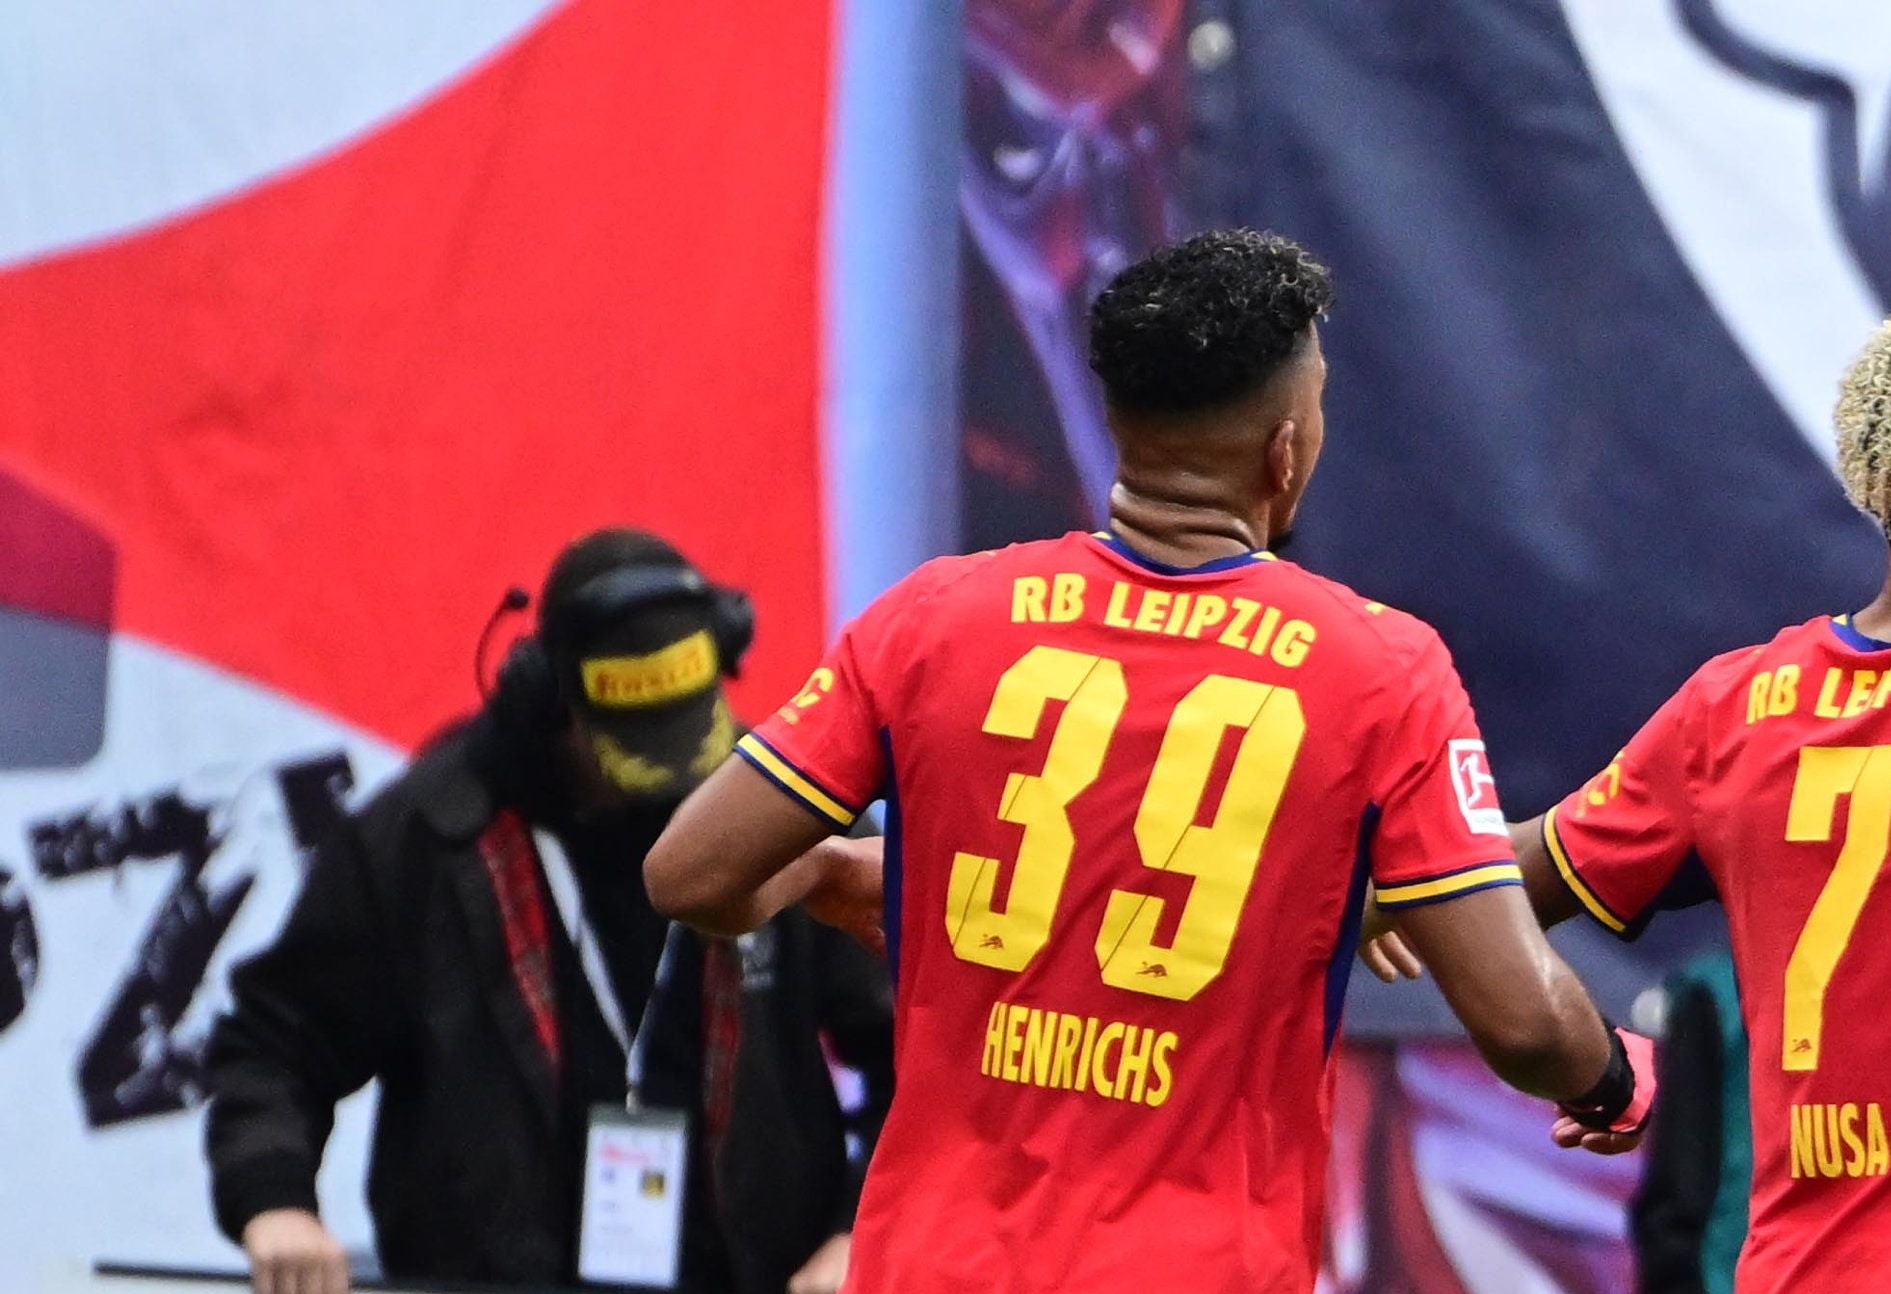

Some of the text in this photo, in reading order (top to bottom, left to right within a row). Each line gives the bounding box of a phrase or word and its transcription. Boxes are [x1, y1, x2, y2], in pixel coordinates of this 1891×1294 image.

[1010, 573, 1317, 669] RB LEIPZIG
[1746, 663, 1802, 725] RB
[944, 644, 1307, 1002] 39
[981, 1001, 1181, 1108] HENRICHS
[1790, 1102, 1891, 1180] NUSA
